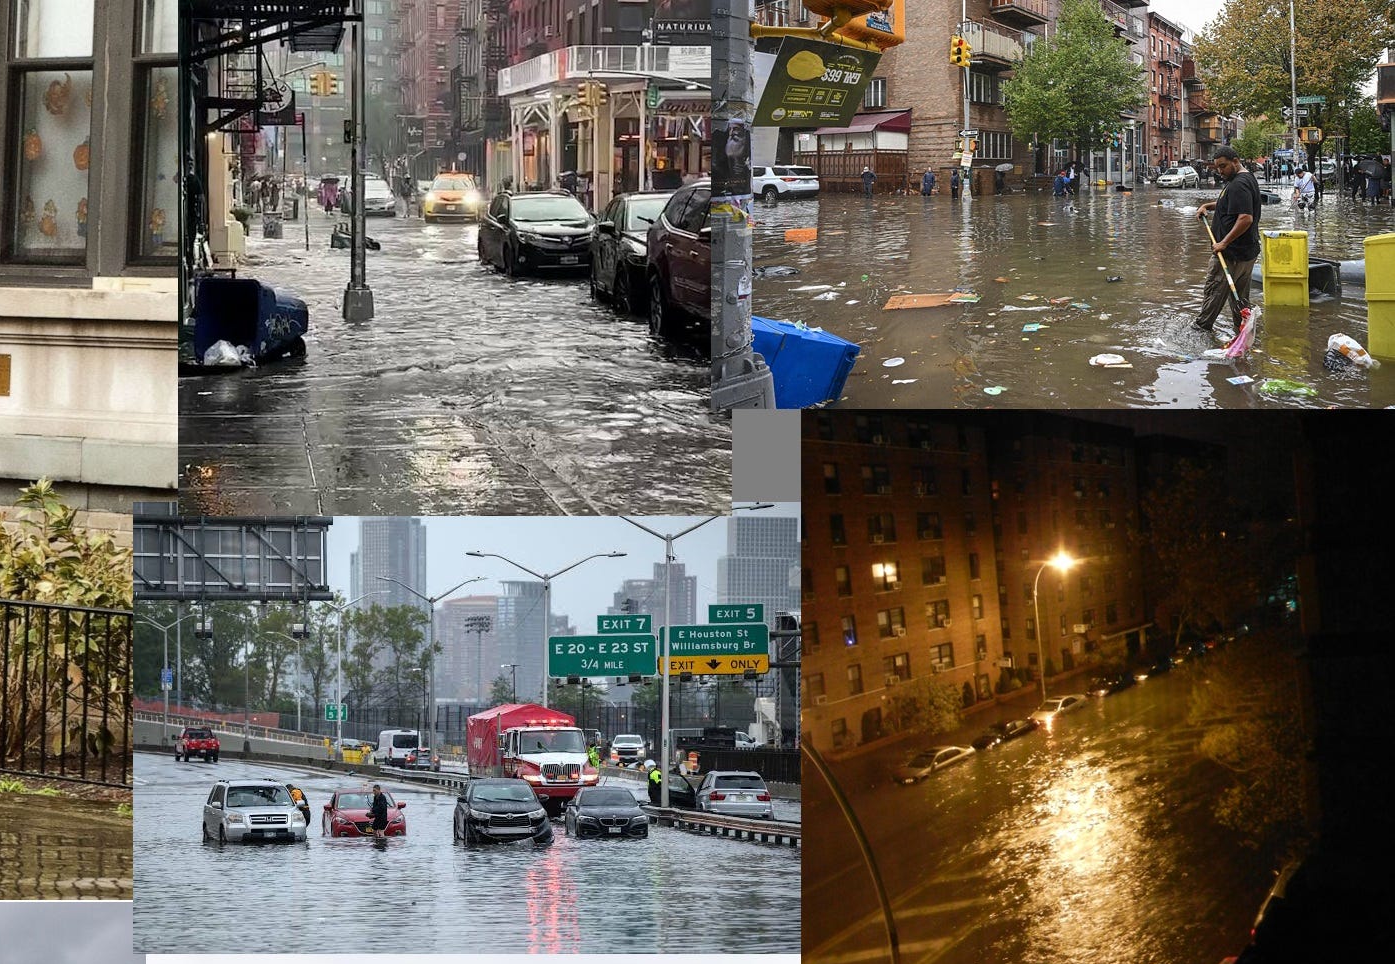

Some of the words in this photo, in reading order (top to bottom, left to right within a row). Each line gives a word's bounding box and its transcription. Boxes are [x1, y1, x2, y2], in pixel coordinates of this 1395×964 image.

[716, 609, 741, 619] EXIT
[746, 607, 756, 620] 5
[602, 619, 631, 630] EXIT
[636, 618, 646, 630] 7
[678, 630, 685, 639] E
[689, 630, 732, 639] Houston
[736, 629, 749, 638] St
[555, 643, 564, 655] E
[567, 643, 586, 655] 20
[598, 643, 607, 654] E
[611, 642, 629, 654] 23
[633, 642, 649, 654] ST
[671, 641, 739, 651] Williamsburg
[743, 640, 756, 649] Br
[581, 659, 599, 669] 3/4
[604, 660, 624, 670] MILE
[670, 660, 694, 671] EXIT
[730, 659, 760, 670] ONLY
